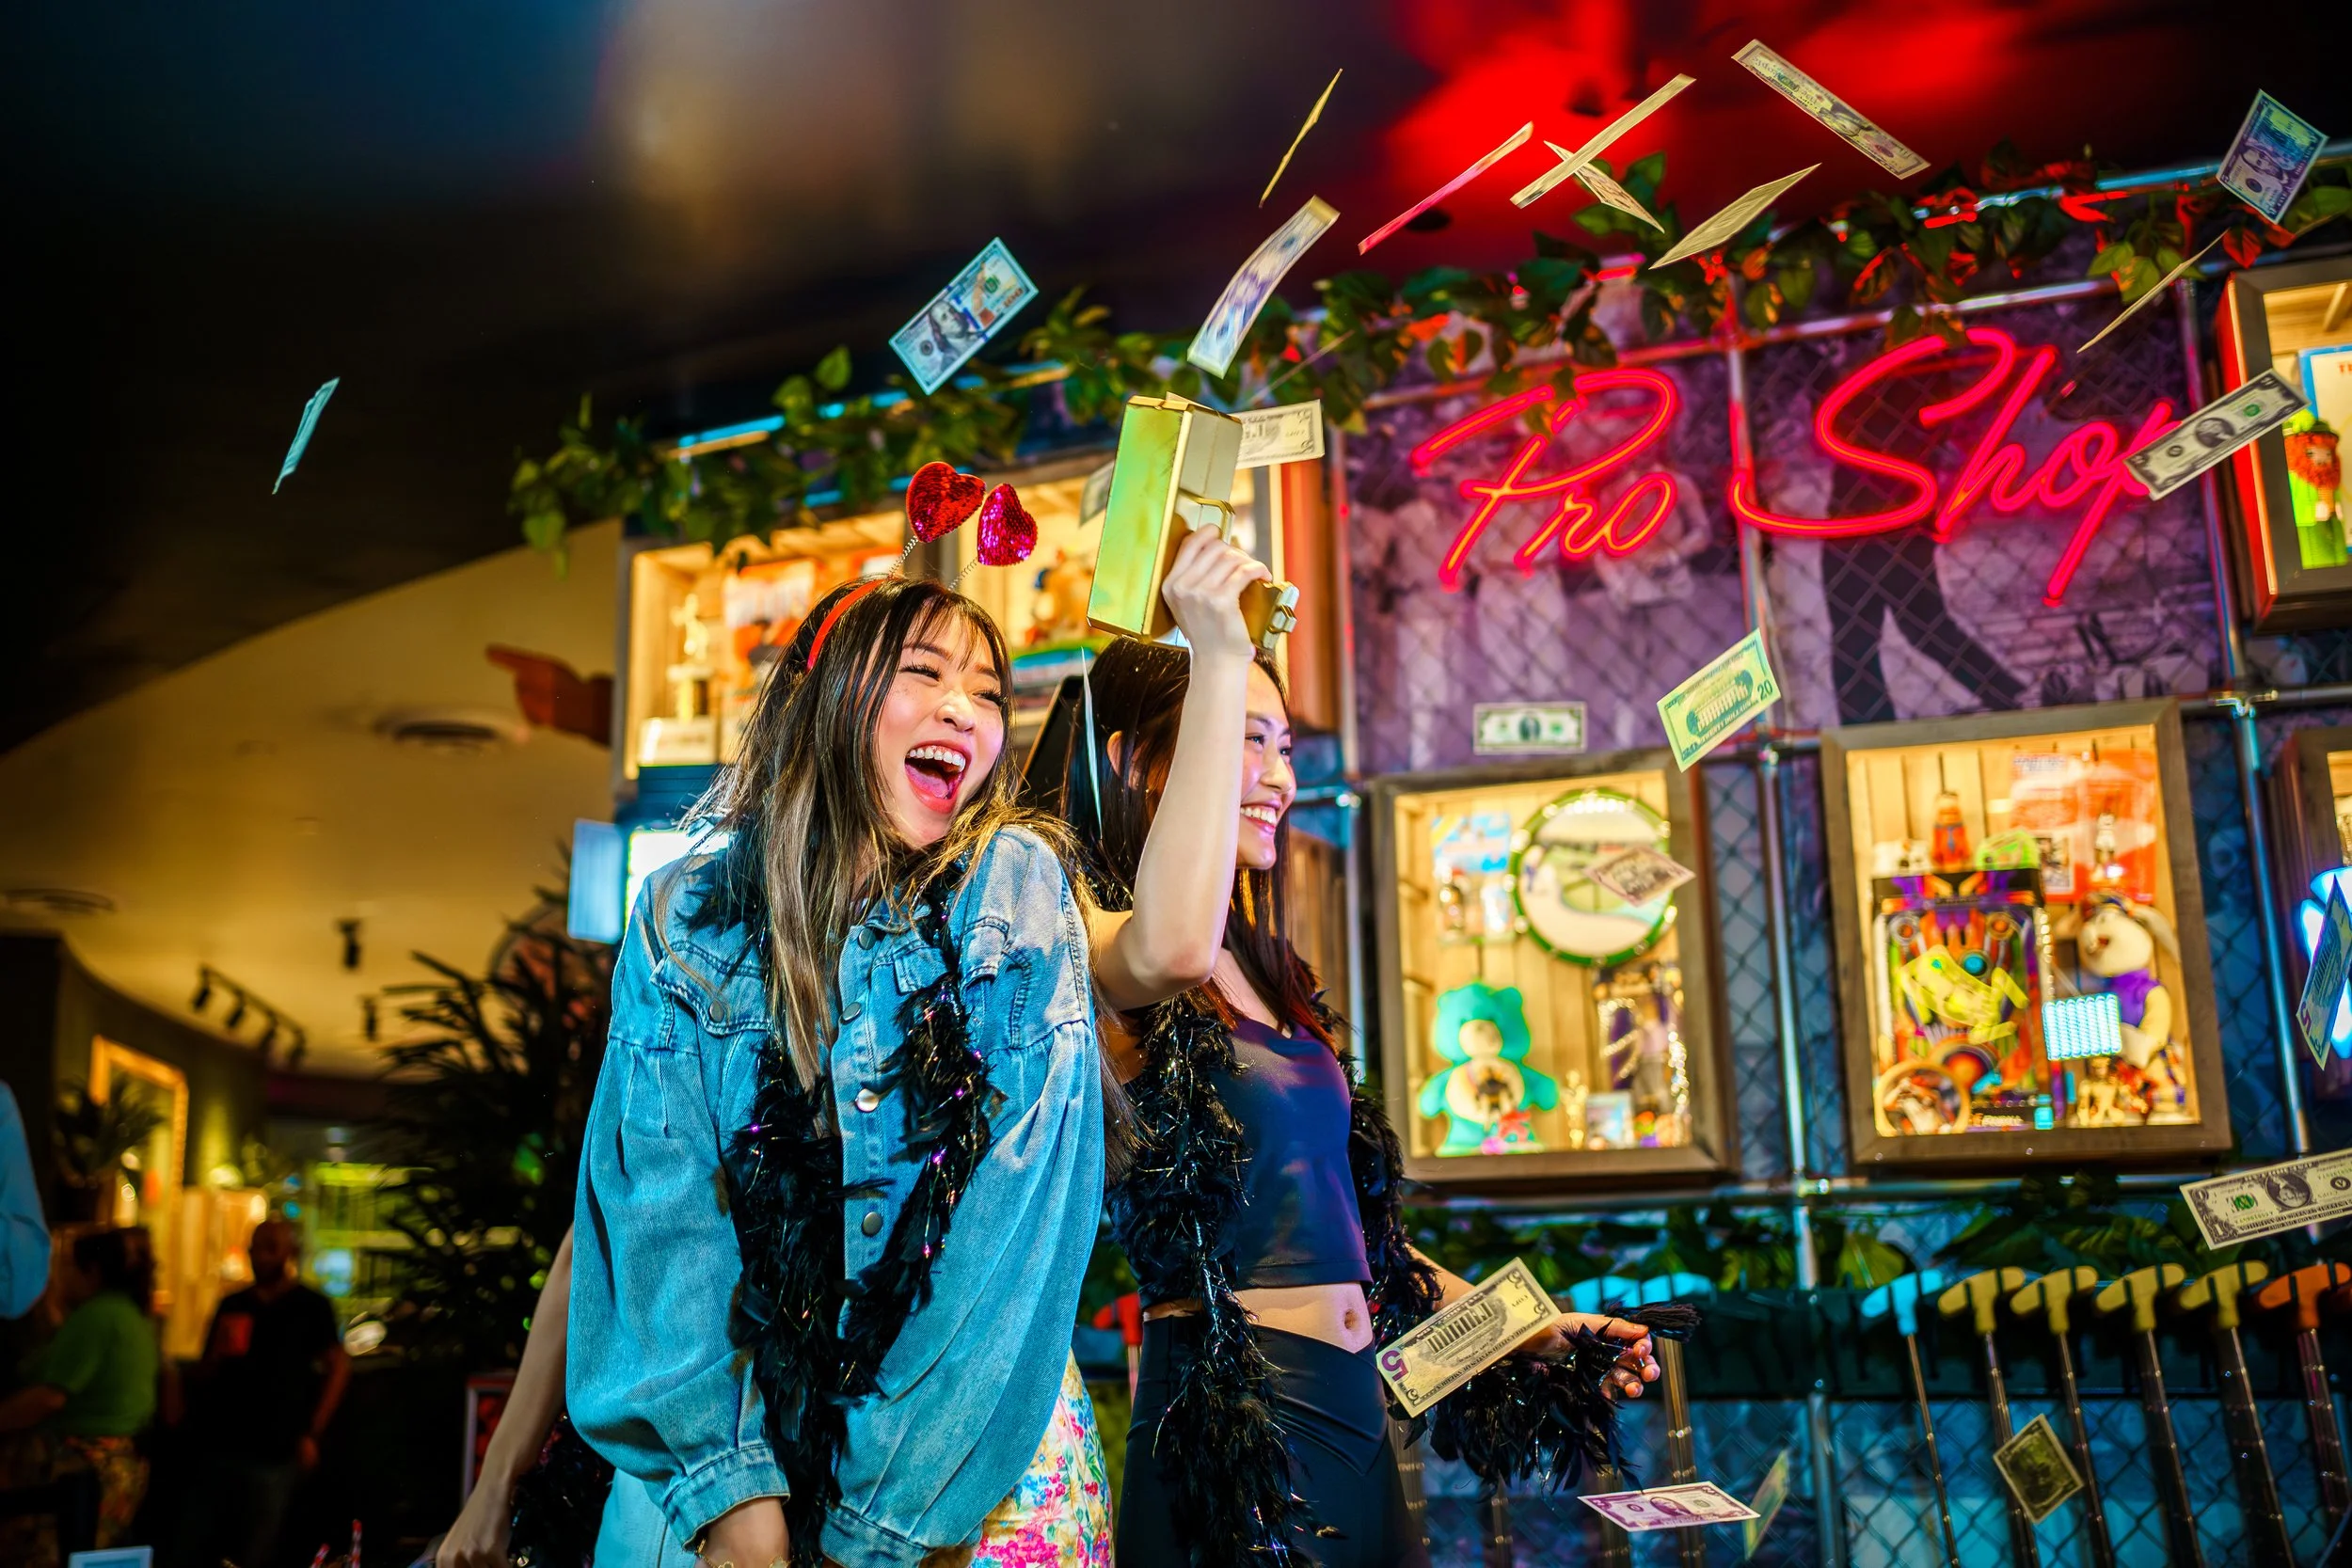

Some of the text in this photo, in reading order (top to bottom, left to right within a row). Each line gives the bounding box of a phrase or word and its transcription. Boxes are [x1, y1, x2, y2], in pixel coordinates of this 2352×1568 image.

[1411, 325, 2183, 607] Pro Shop
[1757, 678, 1773, 701] 20
[1507, 1271, 1523, 1289] 5
[1534, 1303, 1548, 1318] 5
[1380, 1349, 1409, 1382] 5
[1406, 1388, 1421, 1406] 5
